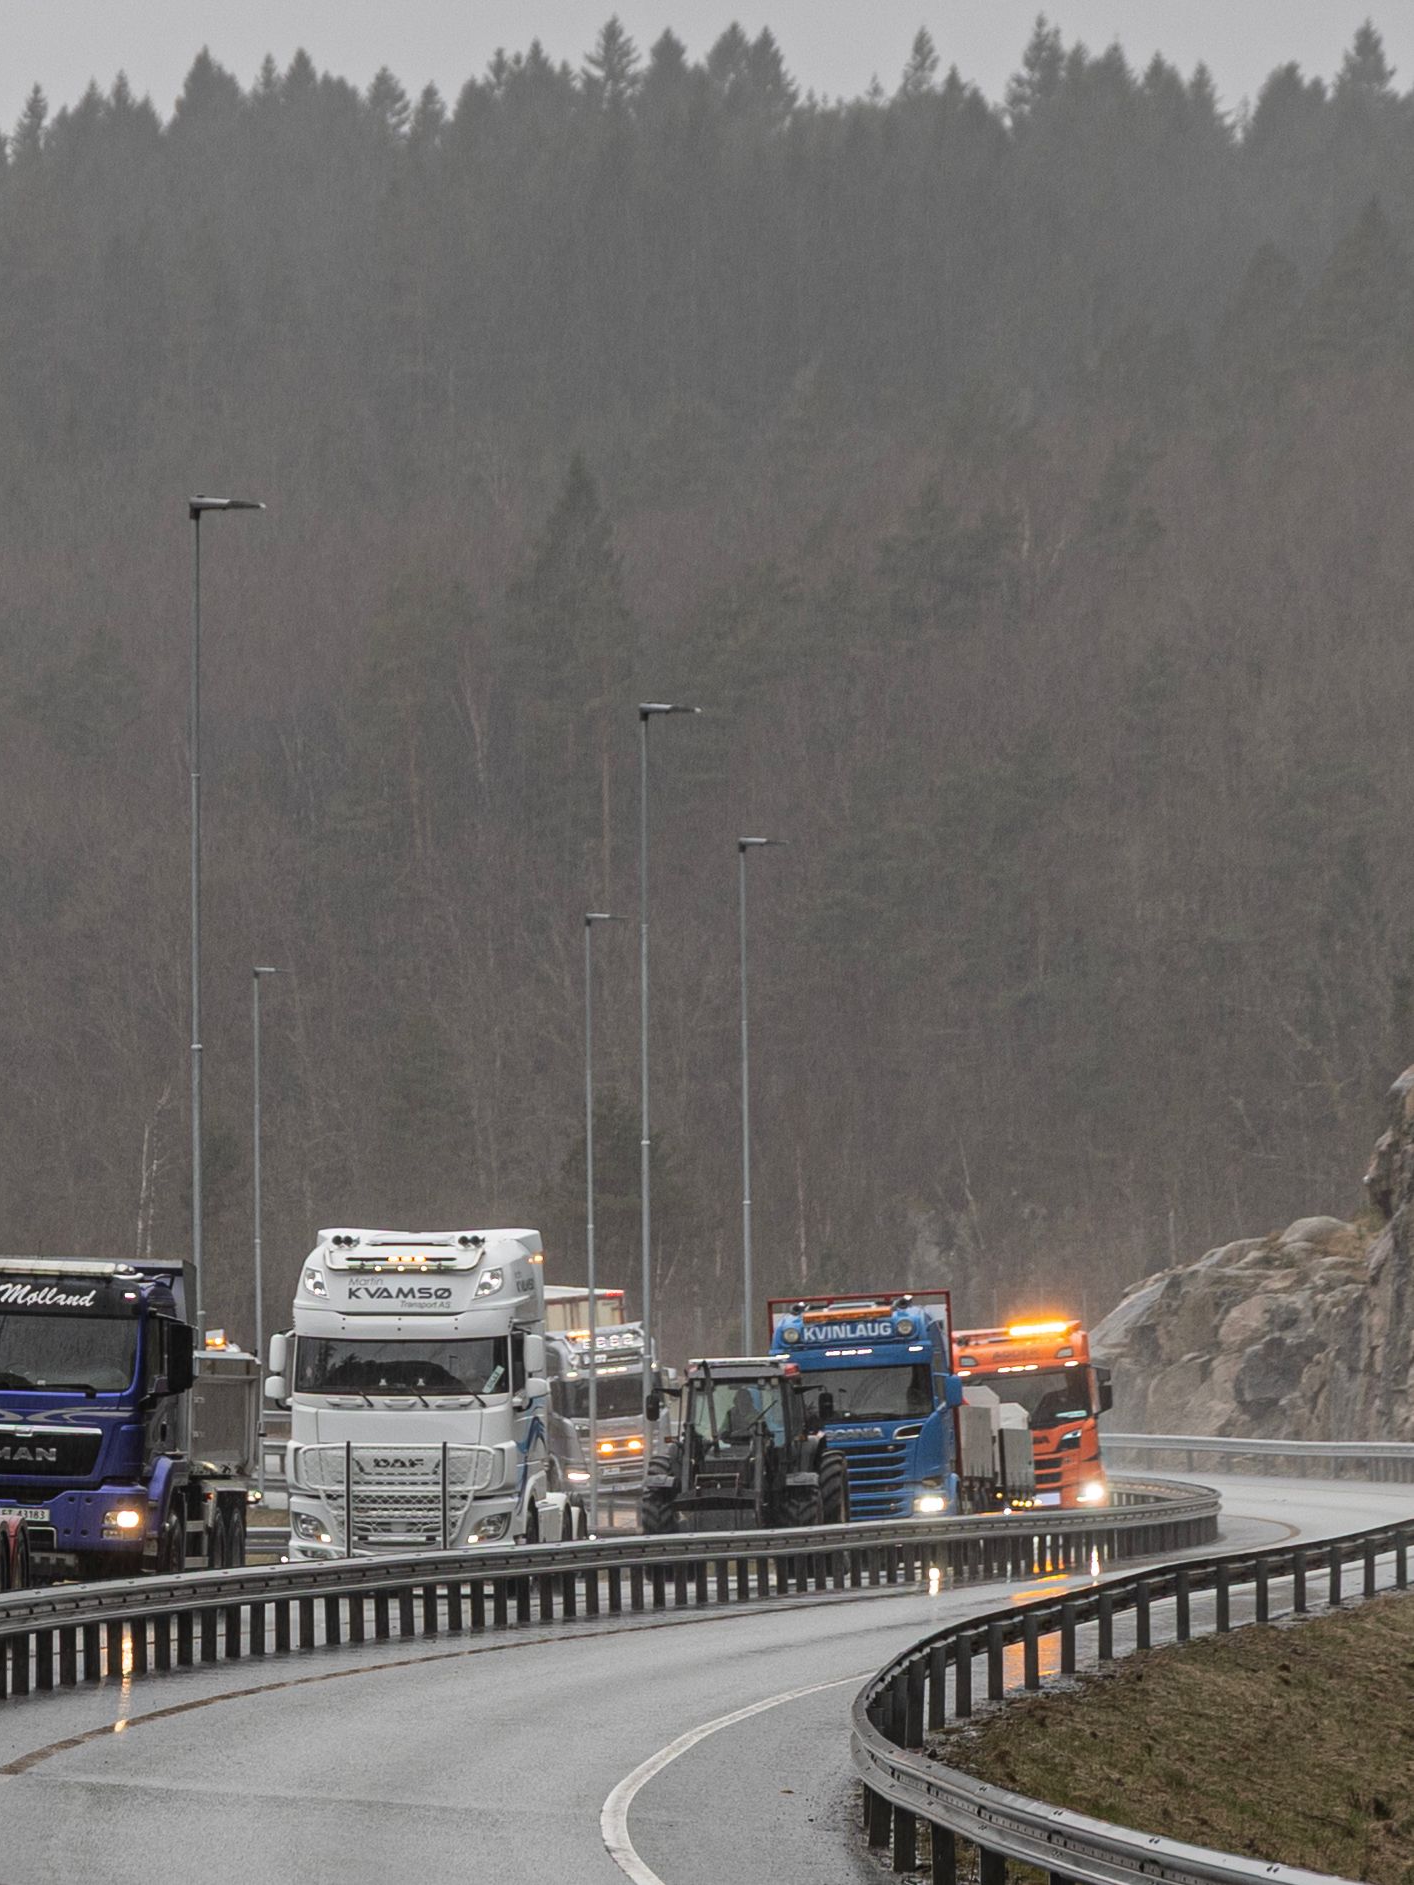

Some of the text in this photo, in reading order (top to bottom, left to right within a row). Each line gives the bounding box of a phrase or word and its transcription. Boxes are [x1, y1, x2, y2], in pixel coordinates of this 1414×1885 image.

[348, 1277, 384, 1287] Martin
[348, 1286, 453, 1300] KVAMSØ
[400, 1300, 451, 1309] Transport AS
[803, 1322, 892, 1341] KVINLAUG
[373, 1458, 425, 1468] DAF
